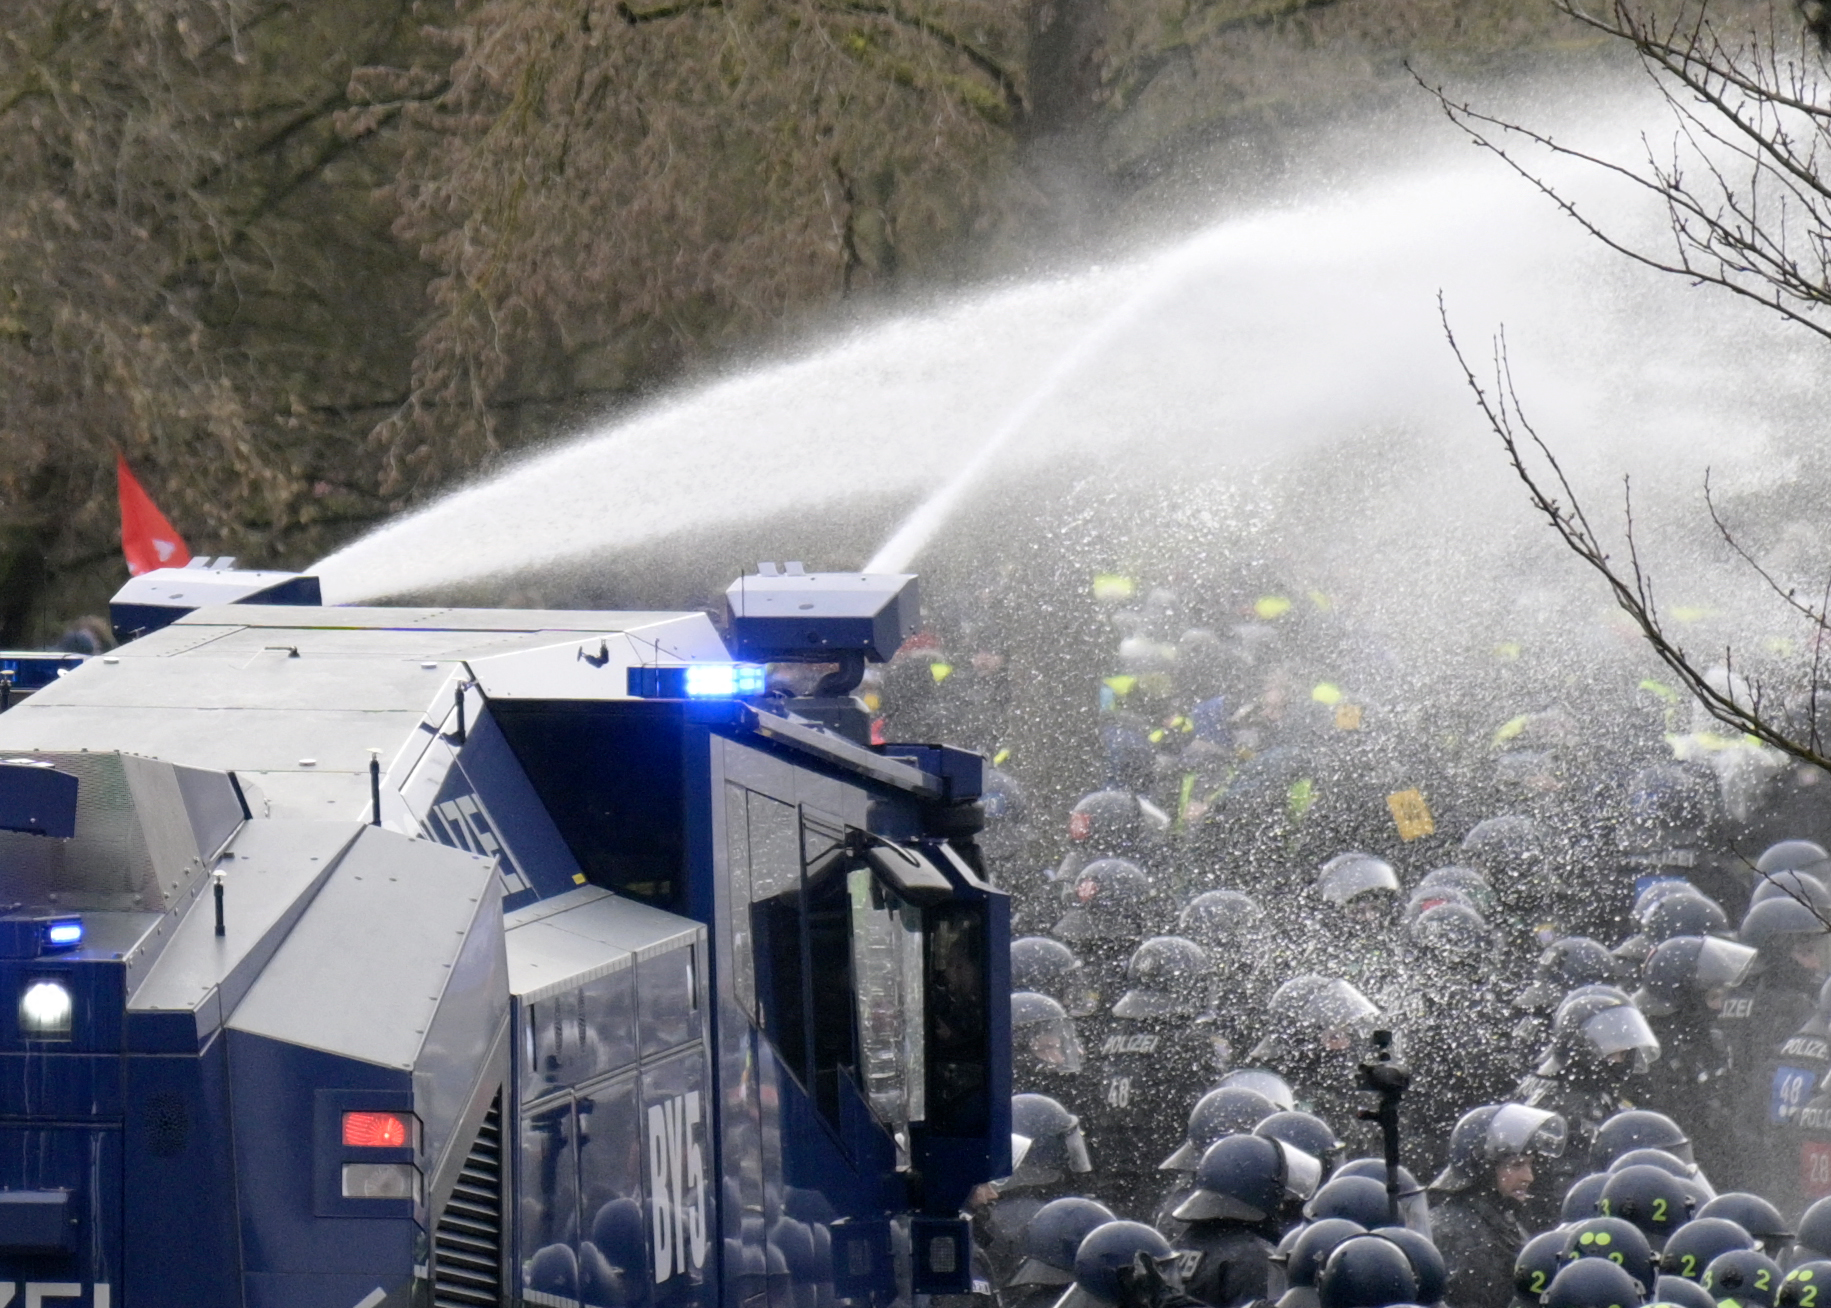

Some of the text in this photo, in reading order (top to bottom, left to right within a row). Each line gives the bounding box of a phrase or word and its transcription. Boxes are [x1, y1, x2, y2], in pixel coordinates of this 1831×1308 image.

[1718, 1000, 1753, 1018] IZEI
[1652, 1199, 1667, 1221] 2
[1681, 1254, 1696, 1277] 2
[1529, 1270, 1546, 1293] 2
[1754, 1269, 1771, 1291] 2
[1799, 1285, 1818, 1307] 2
